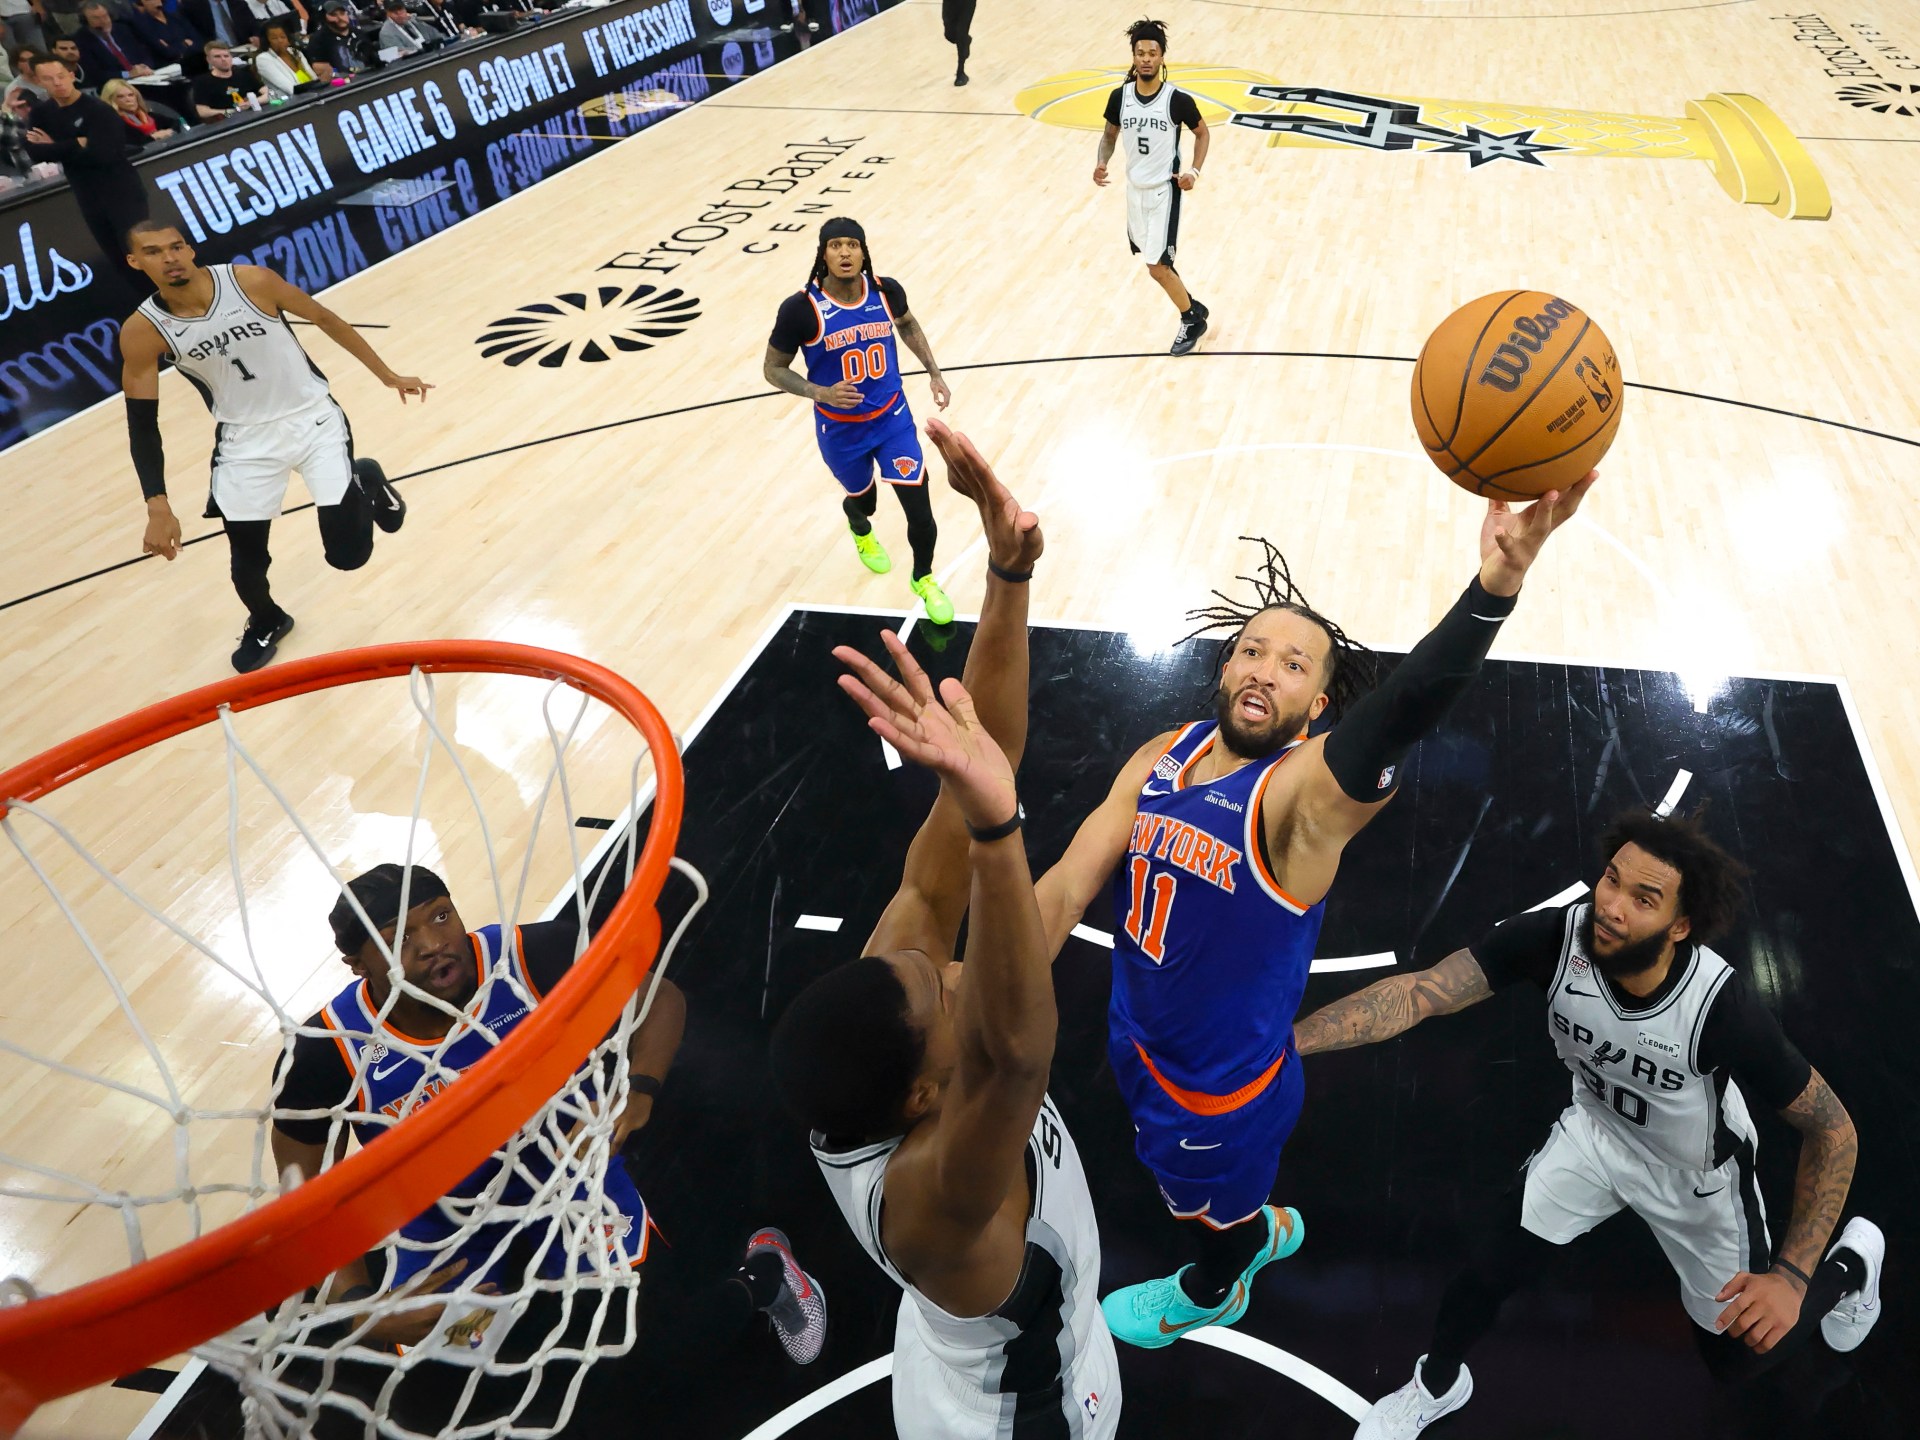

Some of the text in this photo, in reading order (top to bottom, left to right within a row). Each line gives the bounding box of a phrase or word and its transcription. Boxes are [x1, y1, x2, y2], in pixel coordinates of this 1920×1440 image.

[155, 123, 334, 243] TUESDAY
[337, 87, 437, 174] GAME
[422, 80, 456, 140] 6
[457, 50, 553, 126] 8:30PM
[542, 42, 576, 94] ET
[582, 23, 609, 77] IF
[602, 0, 697, 70] NECESSARY
[1137, 136, 1150, 155] 5
[595, 136, 867, 275] Frost Bank
[742, 156, 895, 254] CENTER
[231, 357, 256, 381] 1
[823, 321, 894, 351] NEW YORK
[841, 342, 887, 385] 00
[1479, 297, 1578, 393] Wilson
[1204, 794, 1243, 813] abu dhabi
[1154, 815, 1243, 895] YORK
[1124, 854, 1177, 966] 11
[1643, 1037, 1674, 1053] LEDGER
[1578, 1059, 1649, 1129] 30
